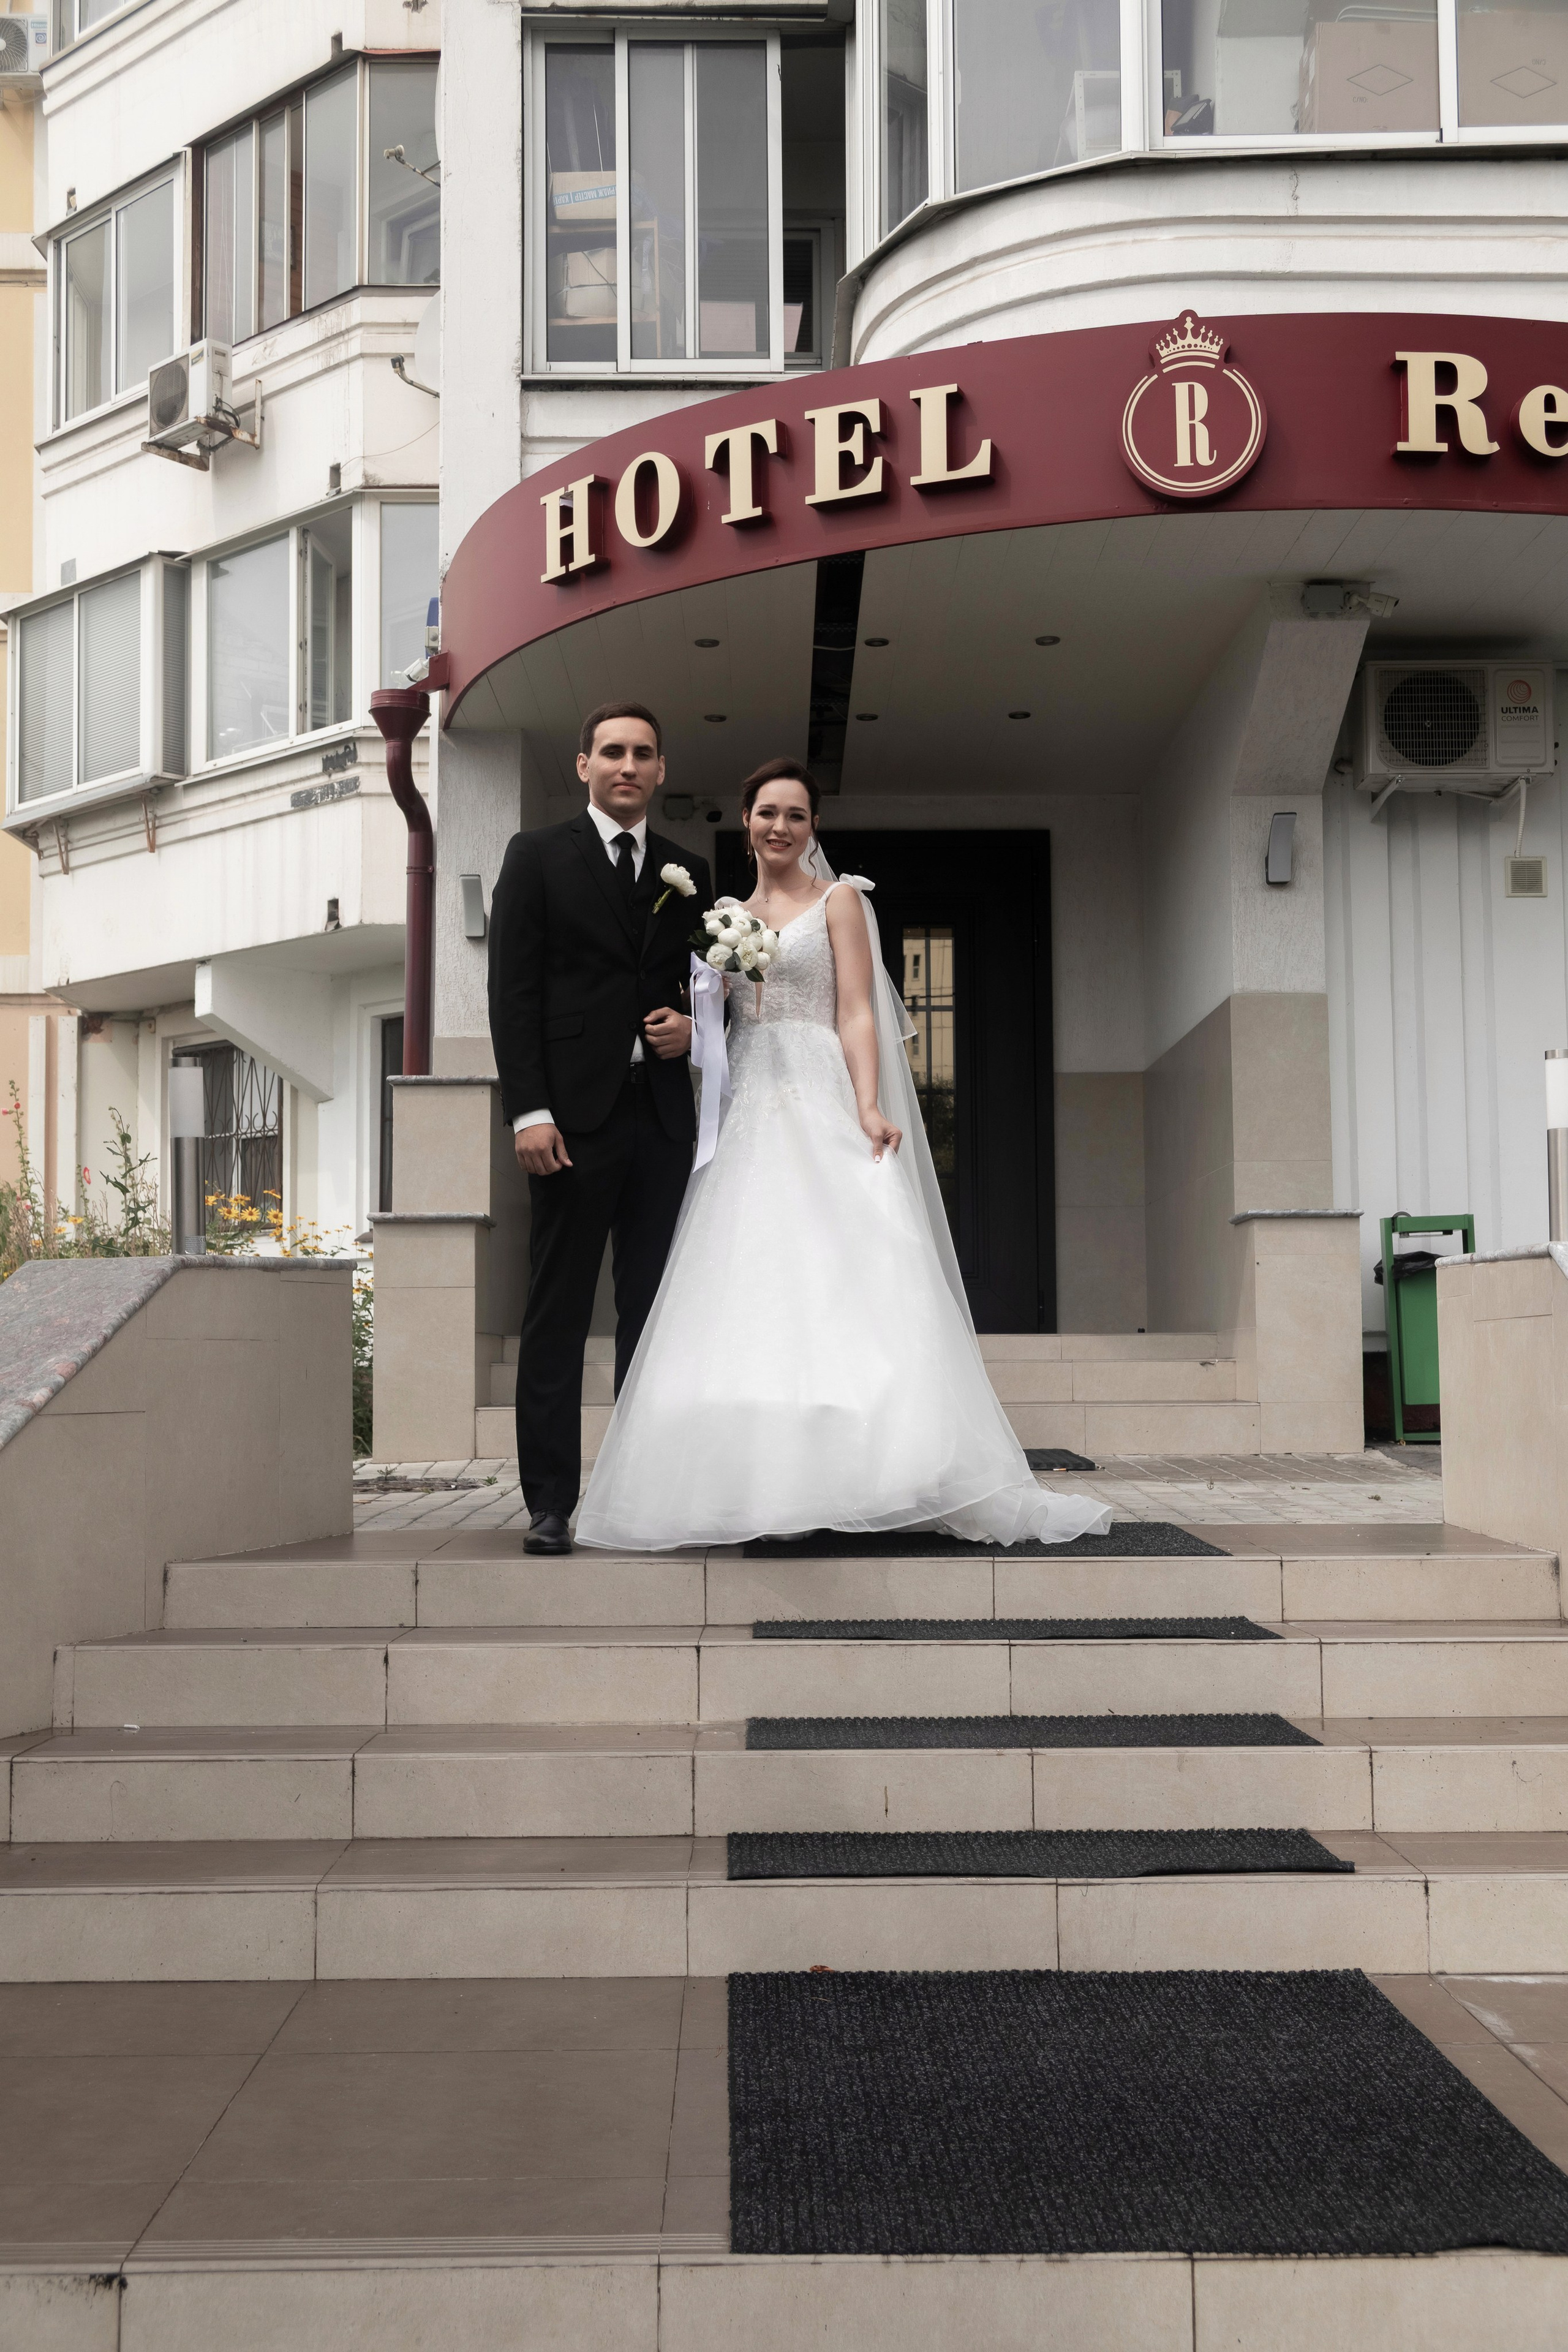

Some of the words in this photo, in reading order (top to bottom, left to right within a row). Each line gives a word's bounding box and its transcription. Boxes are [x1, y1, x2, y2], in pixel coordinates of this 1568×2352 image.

[575, 190, 597, 202] МАСТЕР
[598, 187, 616, 197] РИДЖ
[1171, 381, 1217, 467] R
[1395, 351, 1568, 458] Re
[540, 383, 992, 584] HOTEL
